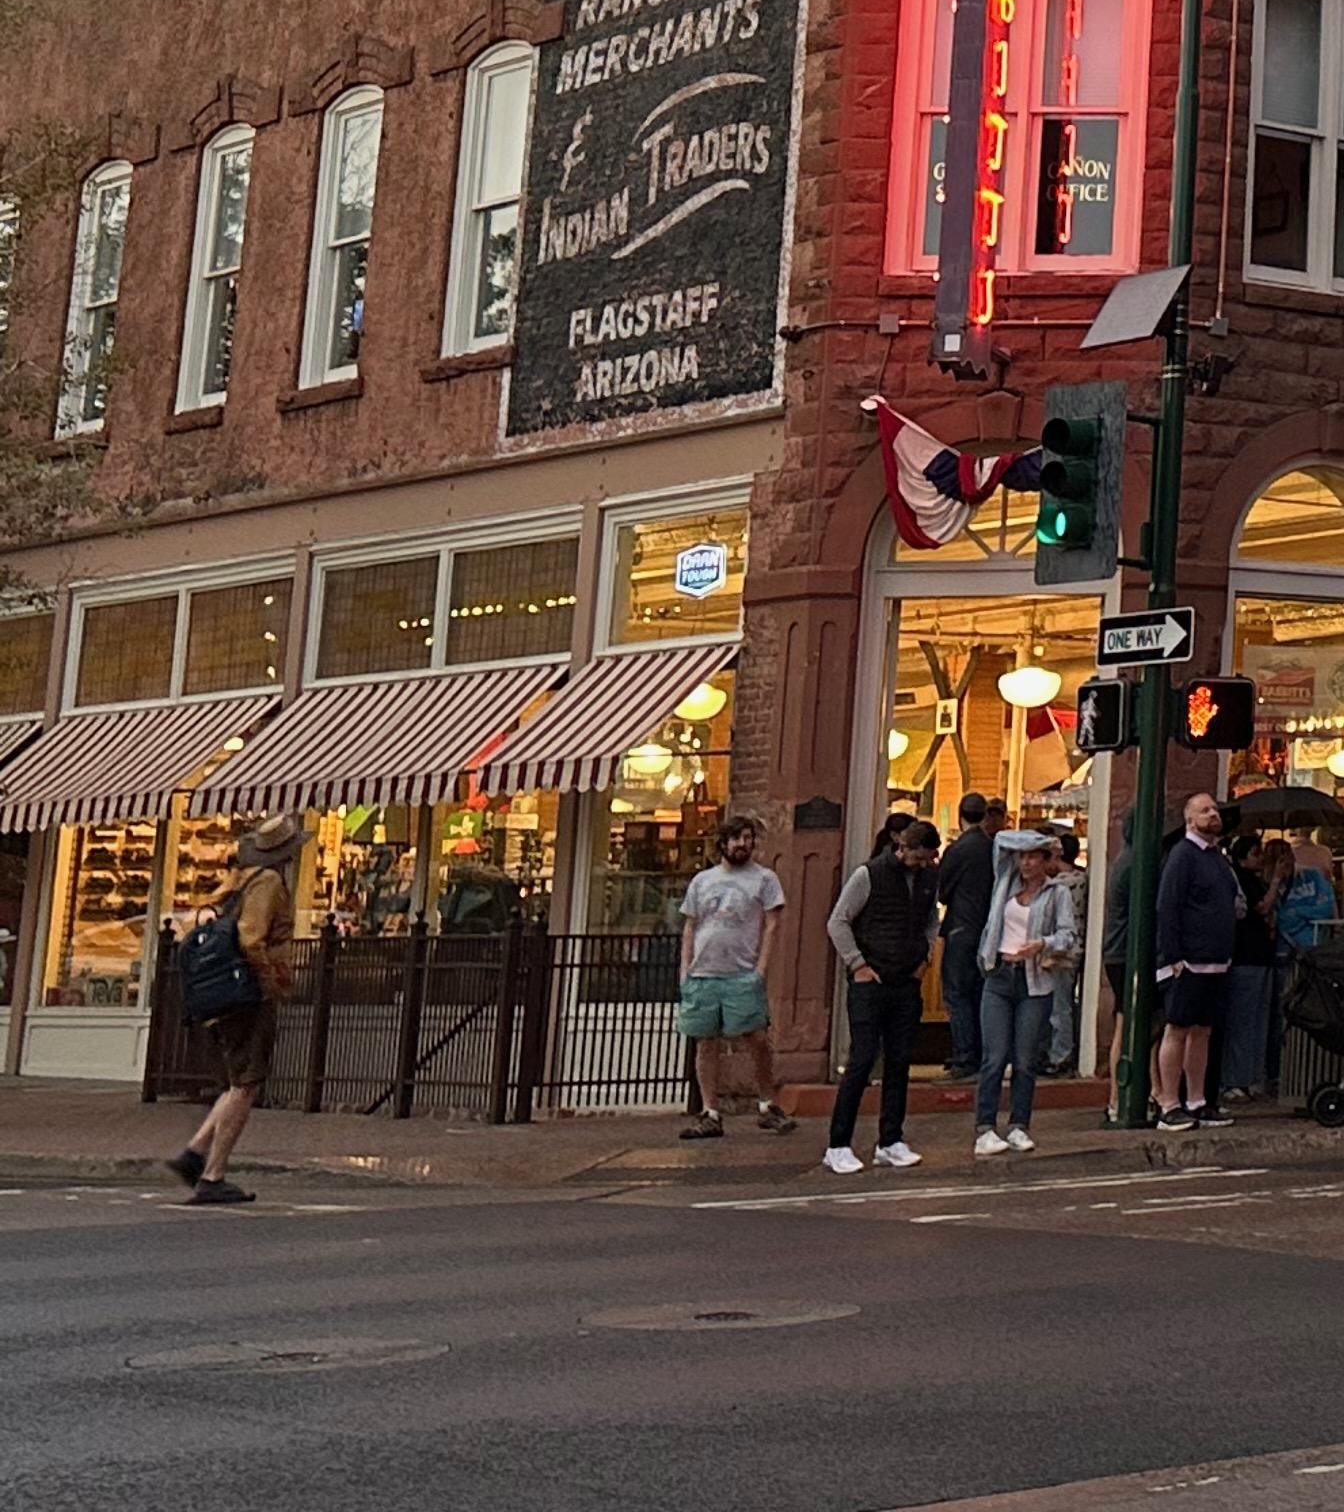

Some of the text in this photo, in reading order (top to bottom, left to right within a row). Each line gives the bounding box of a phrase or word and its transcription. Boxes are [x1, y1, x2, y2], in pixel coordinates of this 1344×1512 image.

[537, 120, 772, 265] INDIAN TRADERS
[569, 282, 721, 350] FLAGSTAFF
[575, 344, 699, 403] ARIZONA
[1107, 627, 1164, 651] ONE WAY
